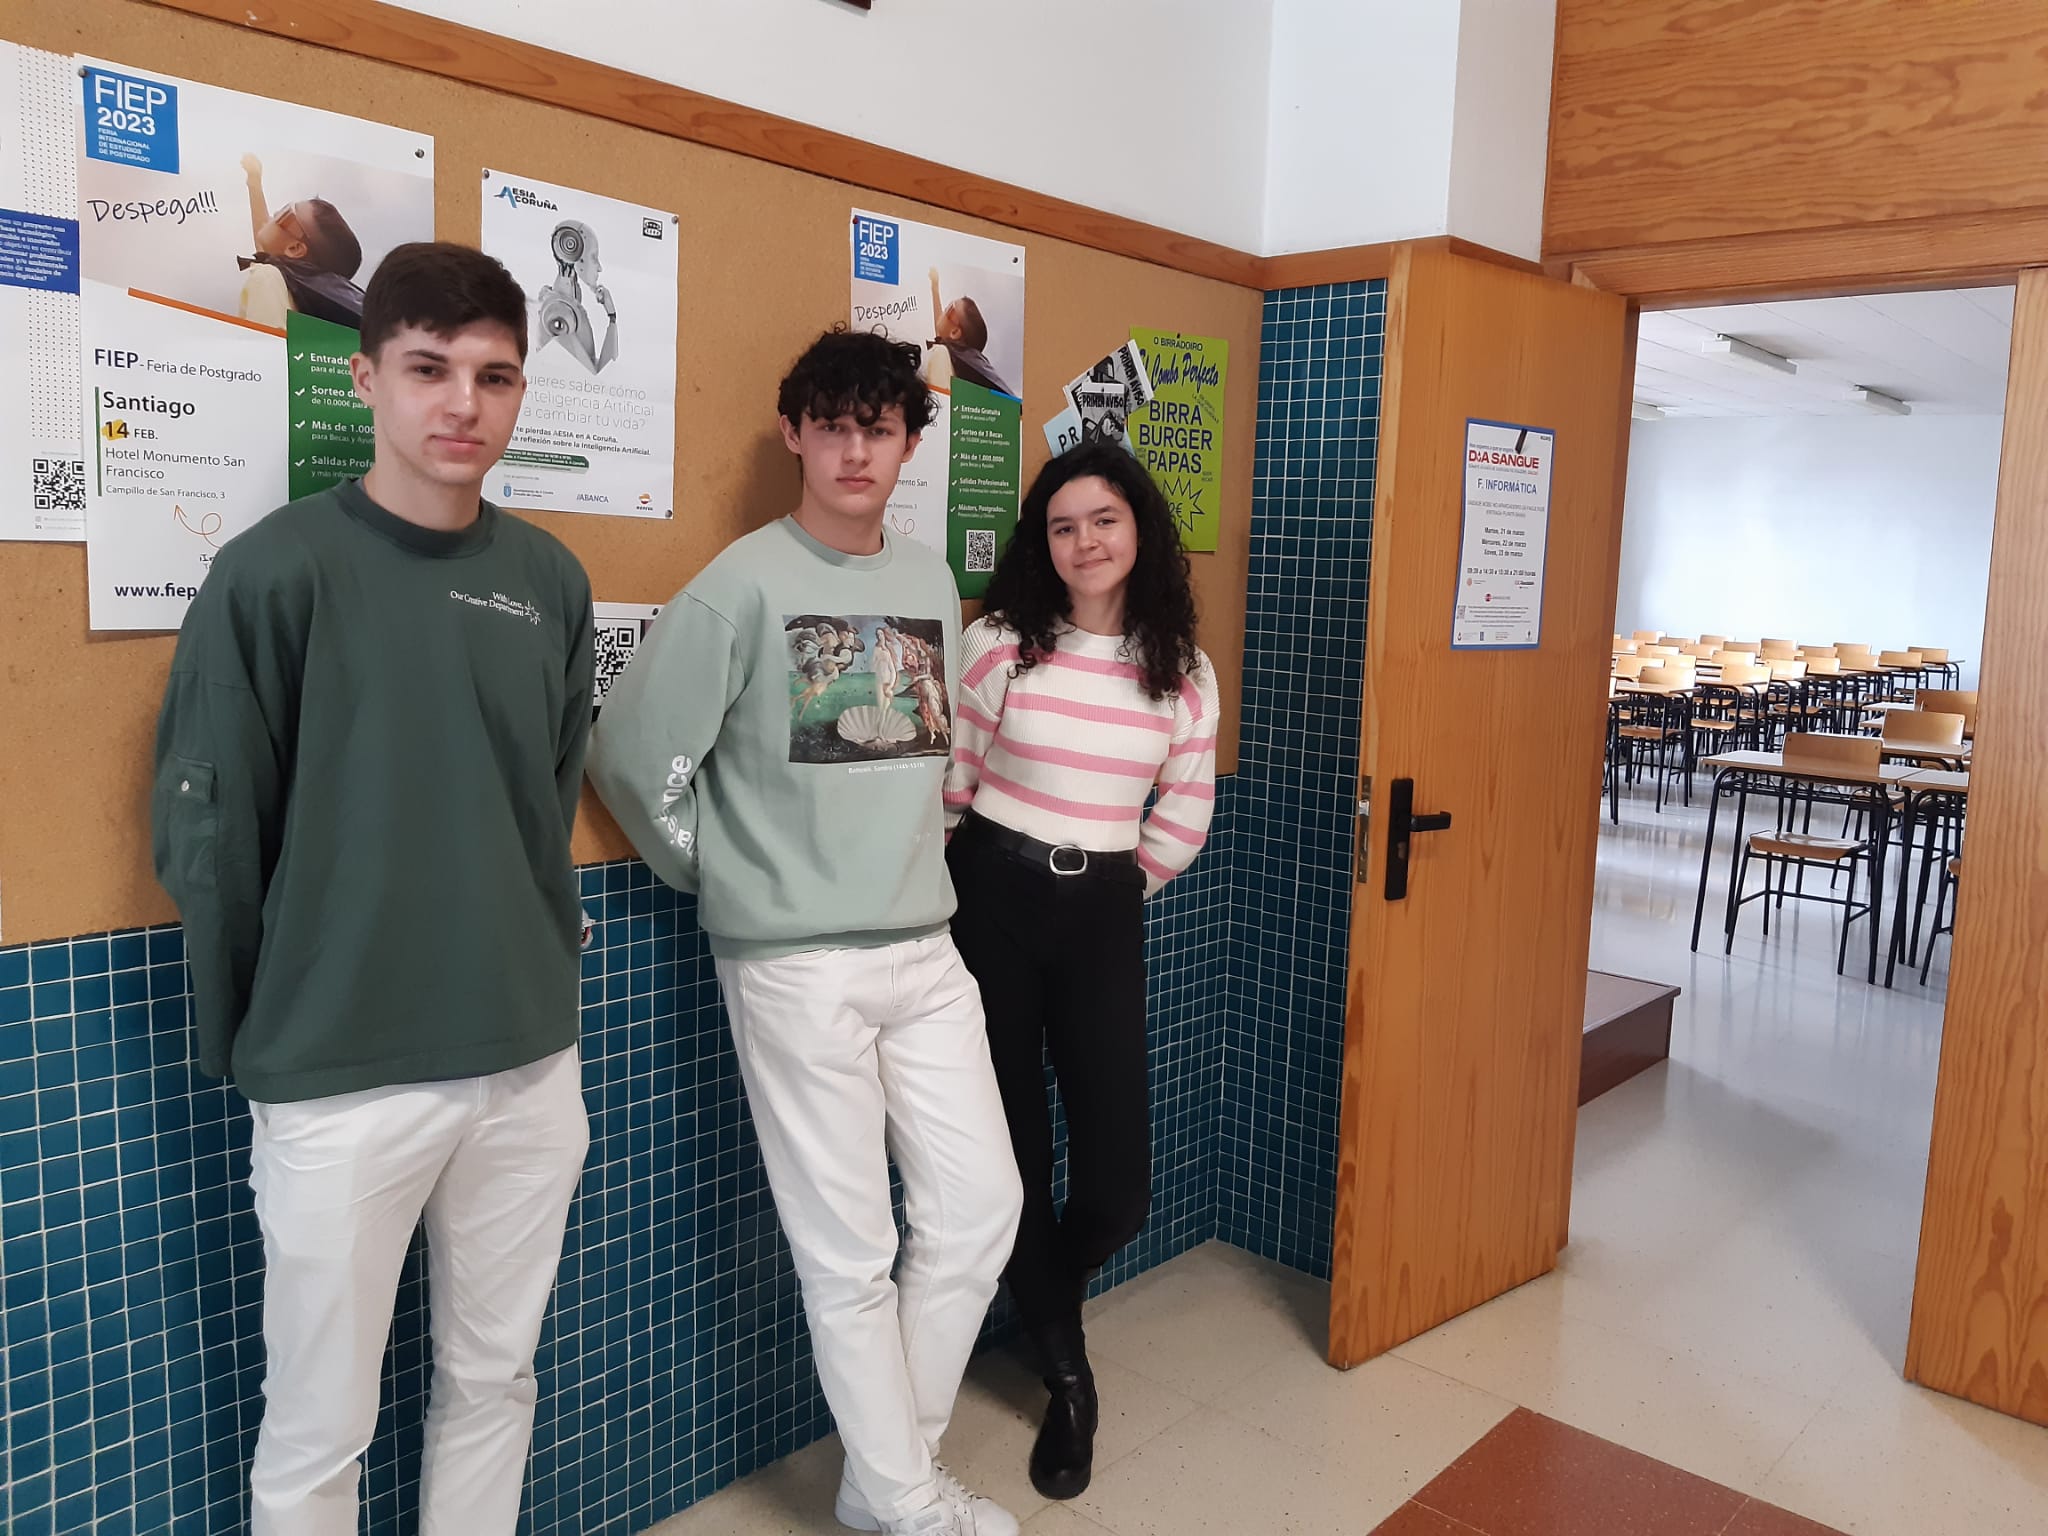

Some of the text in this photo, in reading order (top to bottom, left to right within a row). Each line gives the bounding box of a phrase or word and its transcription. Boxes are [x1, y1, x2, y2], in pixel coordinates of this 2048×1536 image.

[95, 74, 167, 115] FIEP
[97, 106, 156, 136] 2023
[98, 127, 118, 136] FERIA
[98, 134, 150, 150] INTERNACIONAL
[109, 143, 142, 154] ESTUDIOS
[109, 150, 151, 163] POSTGRADO
[87, 191, 219, 224] Despega!!!
[860, 220, 894, 245] FIEP
[860, 242, 888, 260] 2023
[854, 295, 918, 321] Despega!!!
[1160, 337, 1203, 352] BIRRADOIRO
[94, 348, 139, 369] FIEP
[147, 359, 177, 375] Feria
[180, 363, 196, 376] de
[199, 365, 262, 383] Postgrado
[310, 353, 349, 366] Entrada
[311, 365, 327, 374] para
[1151, 353, 1178, 391] Combo
[1182, 352, 1218, 393] Perfecto
[311, 385, 345, 397] Sorteo
[569, 379, 605, 394] saber
[609, 385, 646, 400] cómo
[103, 391, 196, 419] Santiago
[311, 397, 321, 405] de
[604, 399, 654, 417] Artificial
[535, 408, 592, 424] cambiar
[596, 414, 609, 427] tu
[613, 417, 646, 430] vida?
[1150, 399, 1203, 427] BIRRA
[104, 421, 158, 440] 14 FEB.
[311, 420, 332, 431] Más
[334, 422, 347, 432] de
[520, 436, 550, 446] reflexión
[552, 439, 572, 448] sobre
[581, 442, 620, 452] Inteligencia
[1139, 424, 1213, 451] BURGER
[105, 448, 246, 468] Hotel Monumento San
[311, 455, 347, 467] Salidas
[1147, 450, 1203, 474] PAPAS
[1491, 452, 1540, 469] SANGUE
[105, 465, 165, 479] Francisco
[917, 478, 928, 487] San
[1477, 478, 1537, 495] F. INFORMÁTICA
[105, 485, 225, 499] Campillo de San Francisco, 3
[450, 590, 524, 617] Our Creative Department
